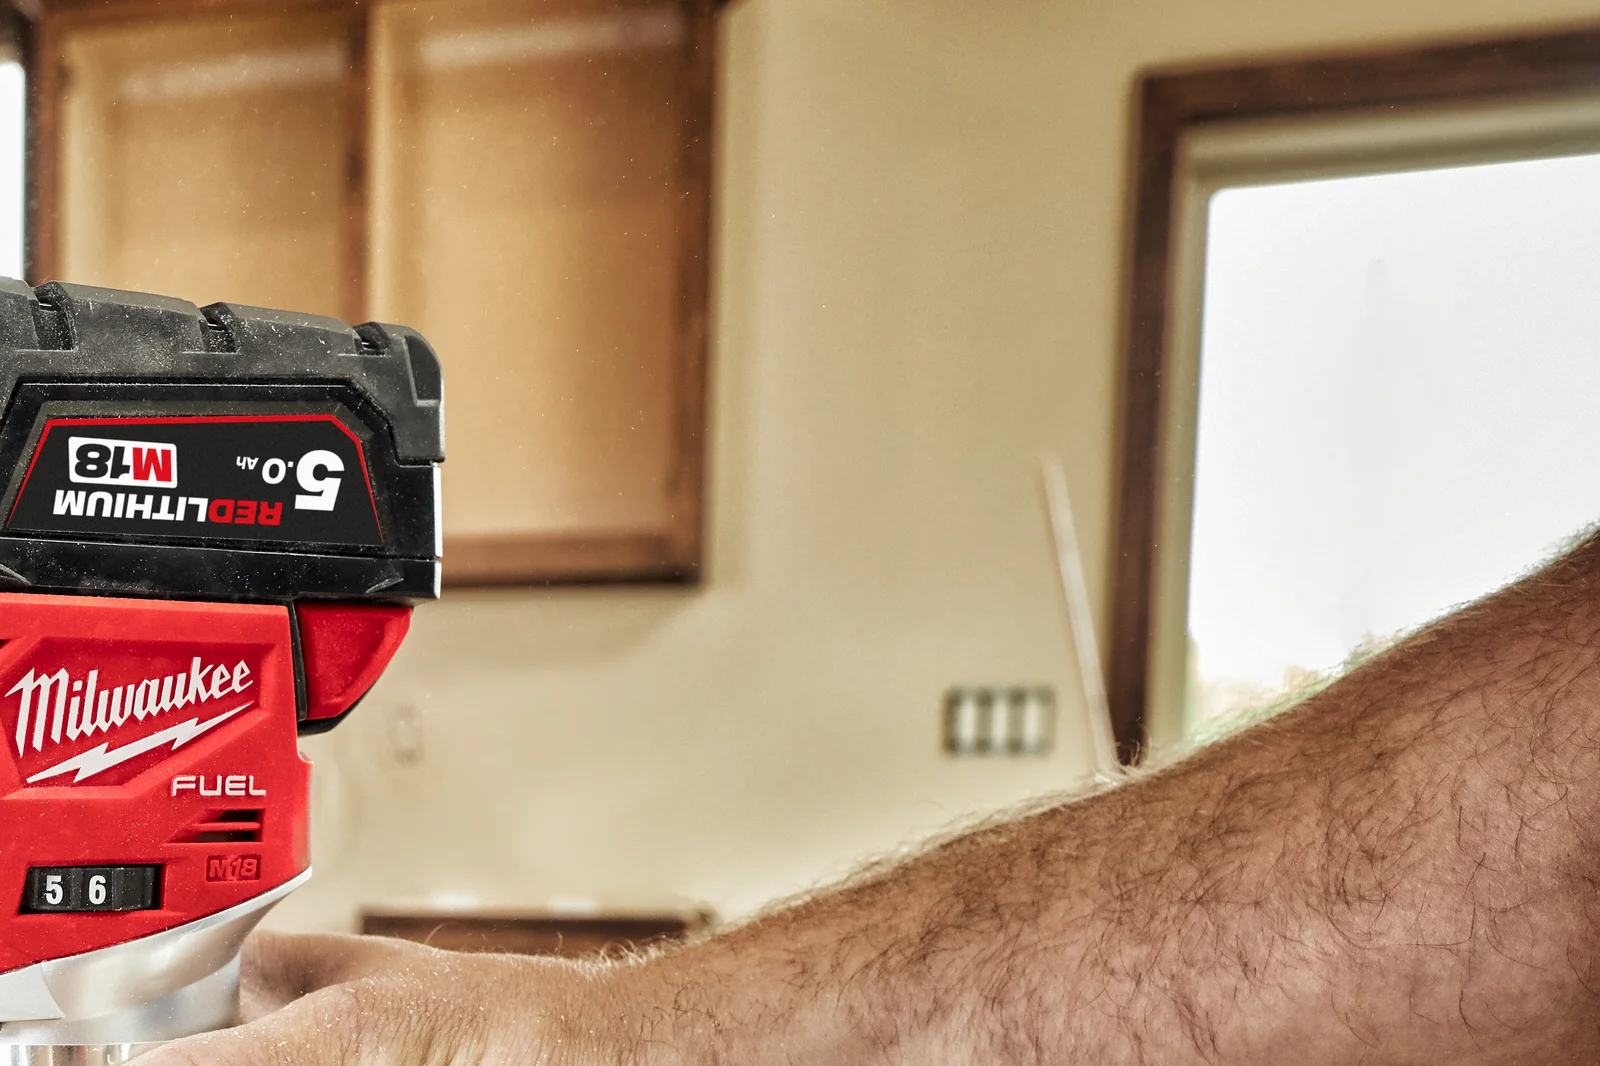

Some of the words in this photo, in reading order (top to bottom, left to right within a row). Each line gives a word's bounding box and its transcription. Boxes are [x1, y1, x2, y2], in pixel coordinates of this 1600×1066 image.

[73, 444, 173, 482] M18
[235, 455, 260, 471] Ah
[261, 449, 345, 511] 5.0
[52, 489, 283, 526] REDLITHIUM
[4, 656, 254, 759] Milwaukee
[171, 775, 267, 797] FUEL
[208, 858, 258, 881] M18
[45, 874, 64, 905] 5
[88, 874, 107, 905] 6
